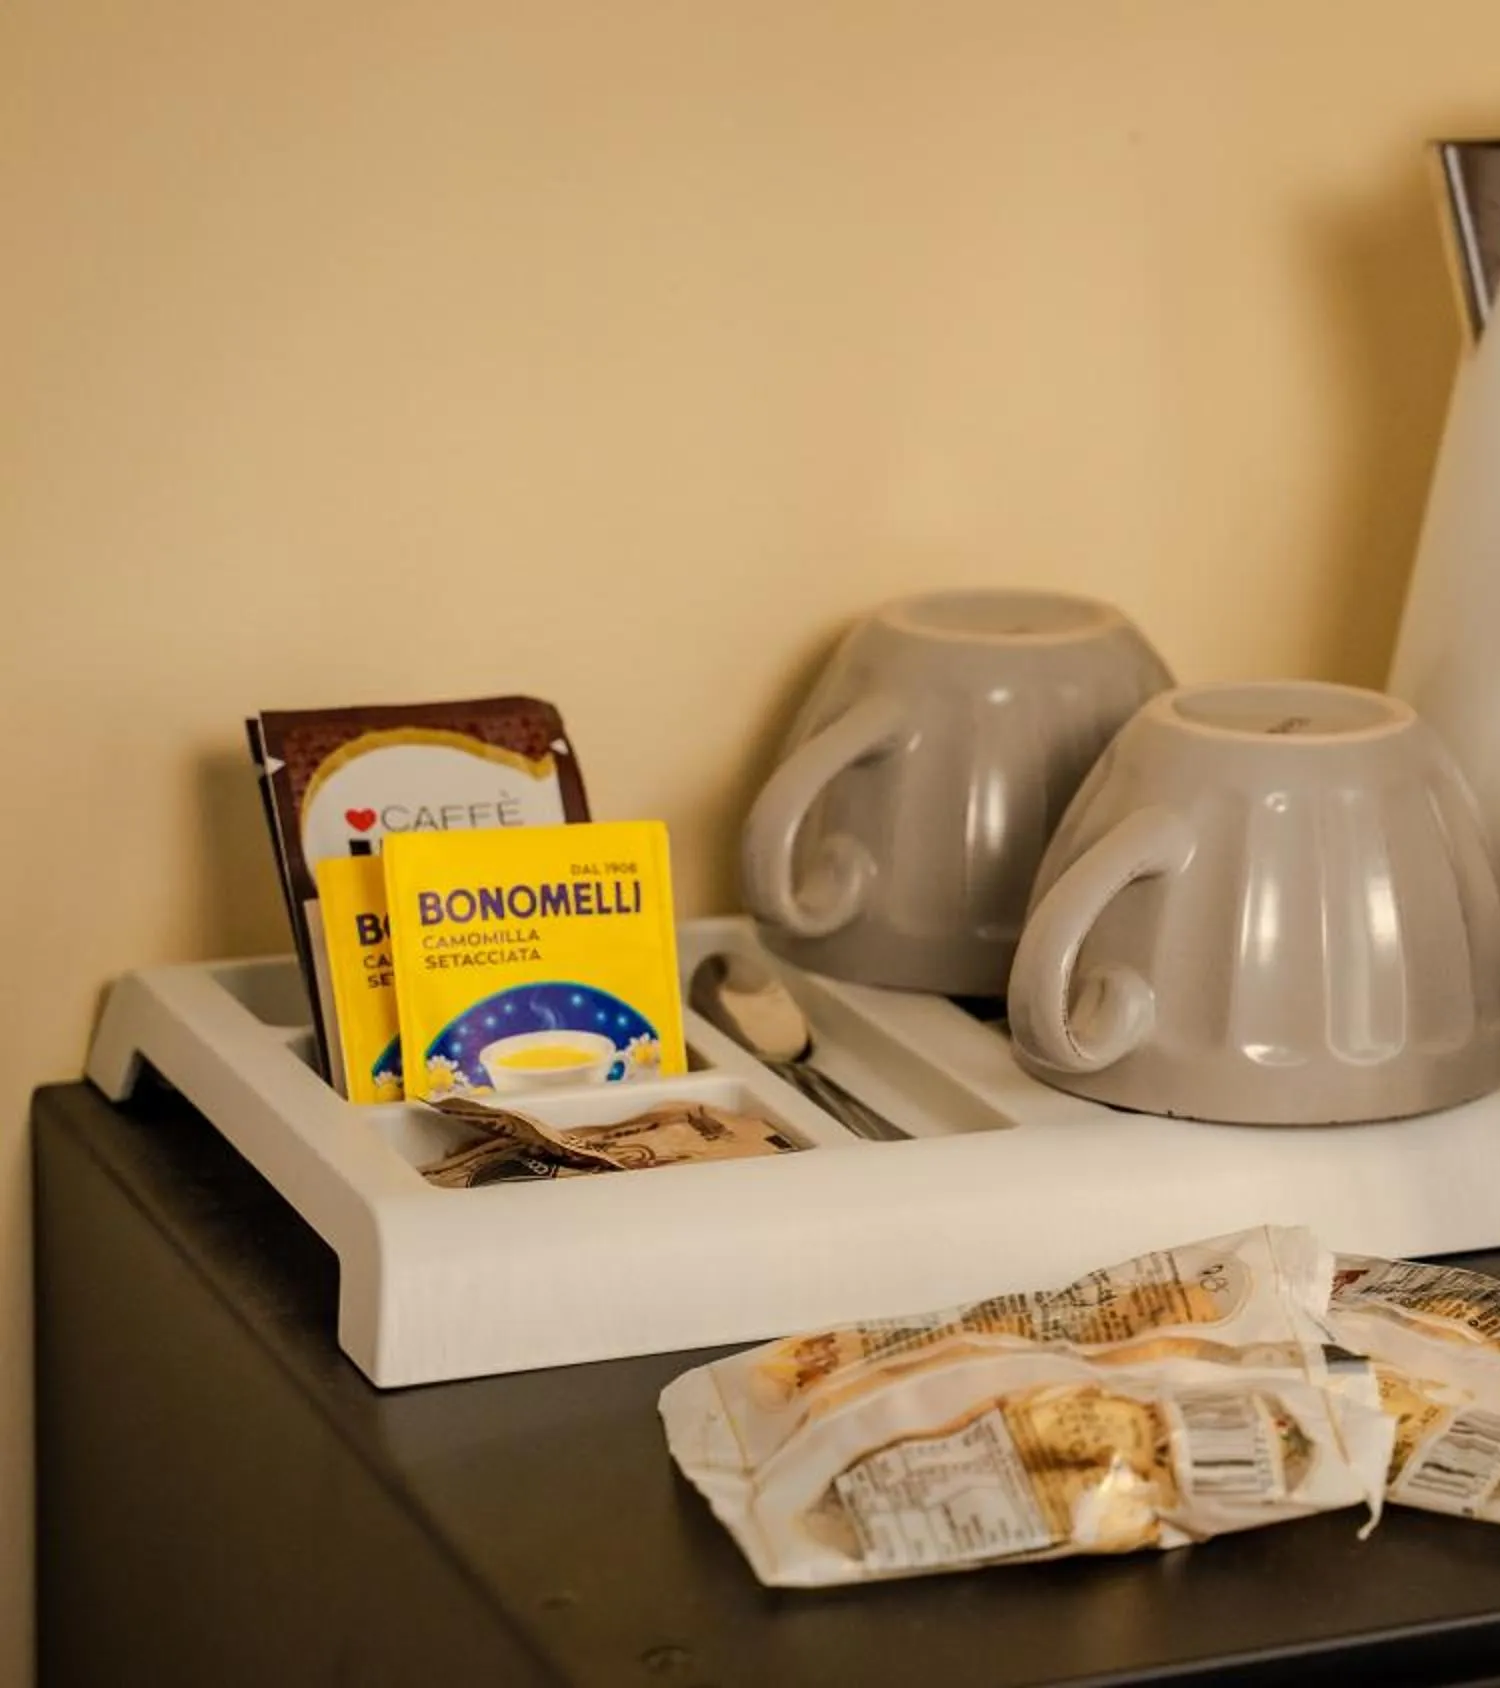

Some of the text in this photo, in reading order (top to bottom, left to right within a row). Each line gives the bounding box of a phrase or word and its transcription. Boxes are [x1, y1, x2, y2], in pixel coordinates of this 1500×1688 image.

[380, 789, 523, 832] CAFFÈ
[571, 863, 600, 876] DAL
[418, 880, 641, 926] BONOMELLI
[422, 928, 541, 950] CAMOMILLA
[424, 947, 542, 970] SETACCIATA
